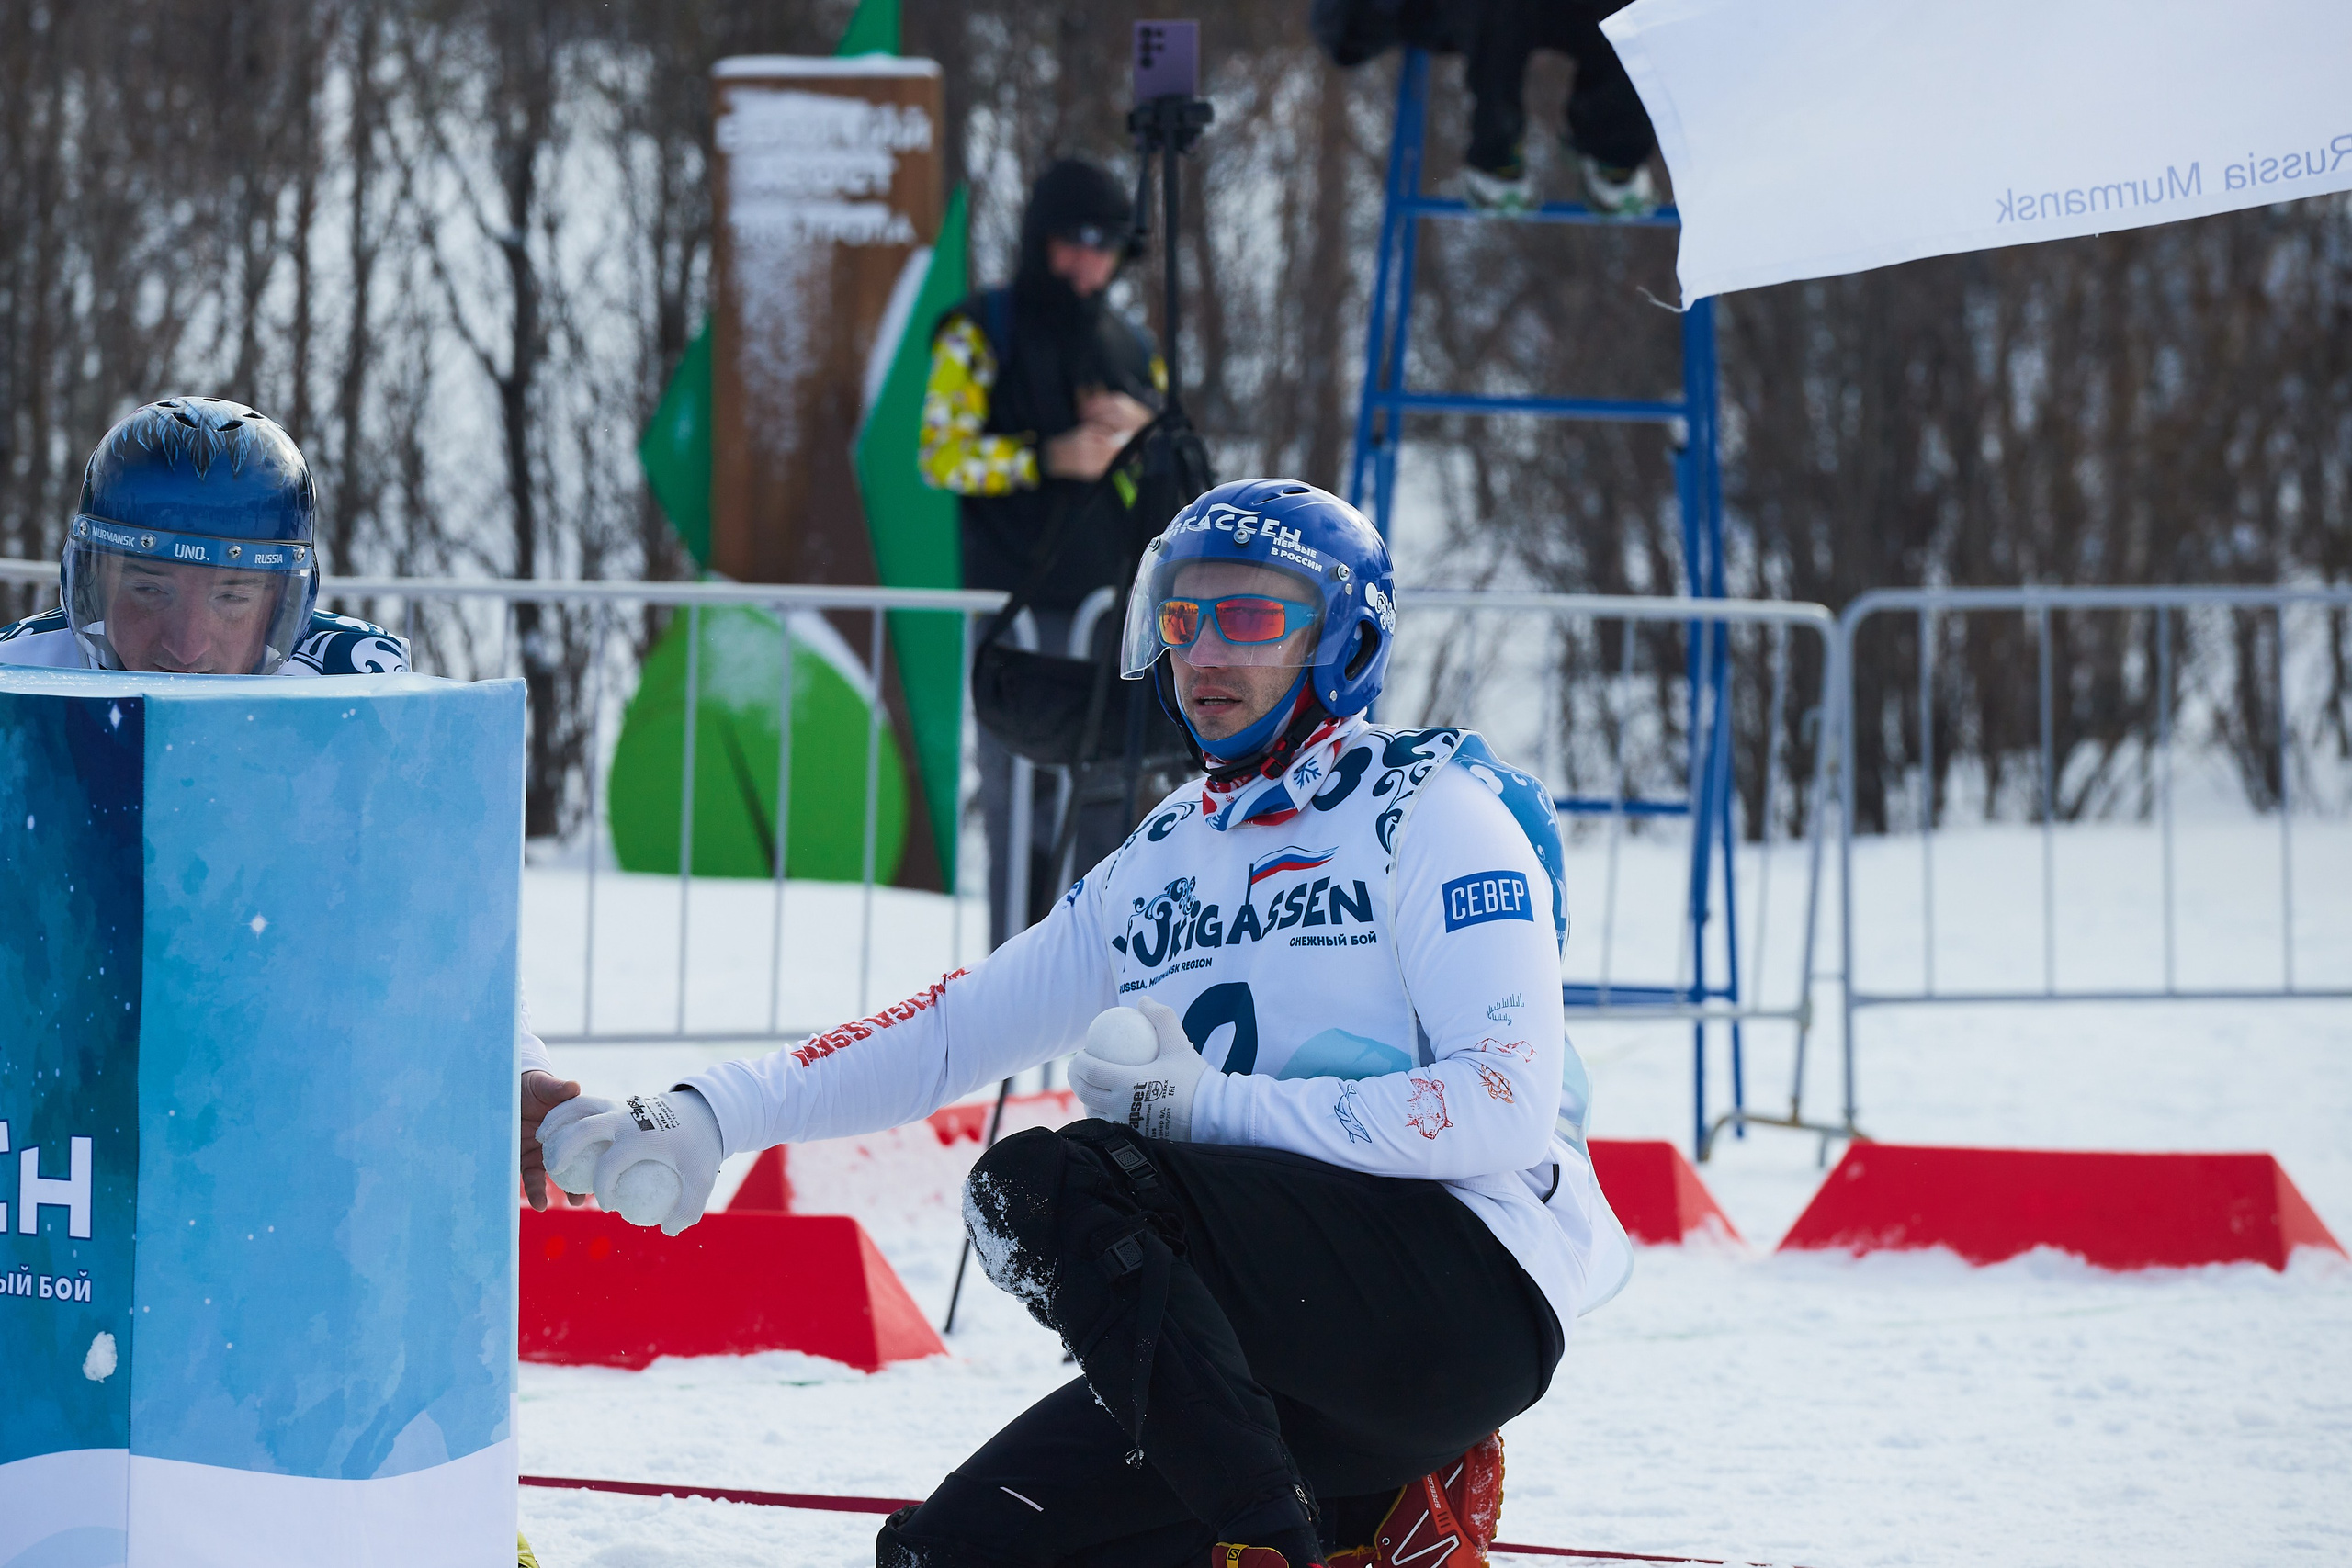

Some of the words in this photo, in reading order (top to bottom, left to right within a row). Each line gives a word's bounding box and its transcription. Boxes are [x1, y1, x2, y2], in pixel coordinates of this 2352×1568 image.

[92, 526, 136, 547] MURMANSK
[1272, 537, 1317, 559] ПЕРВЫЕ
[254, 554, 283, 564] RUSSIA
[1270, 547, 1279, 557] В
[1280, 551, 1323, 573] РОССИИ
[1451, 878, 1525, 921] СЕВЕР
[1289, 933, 1348, 947] СНЕЖНЫЙ
[1350, 931, 1377, 946] БОЙ
[1181, 957, 1213, 972] REGION
[39, 1270, 91, 1303] БОЙ
